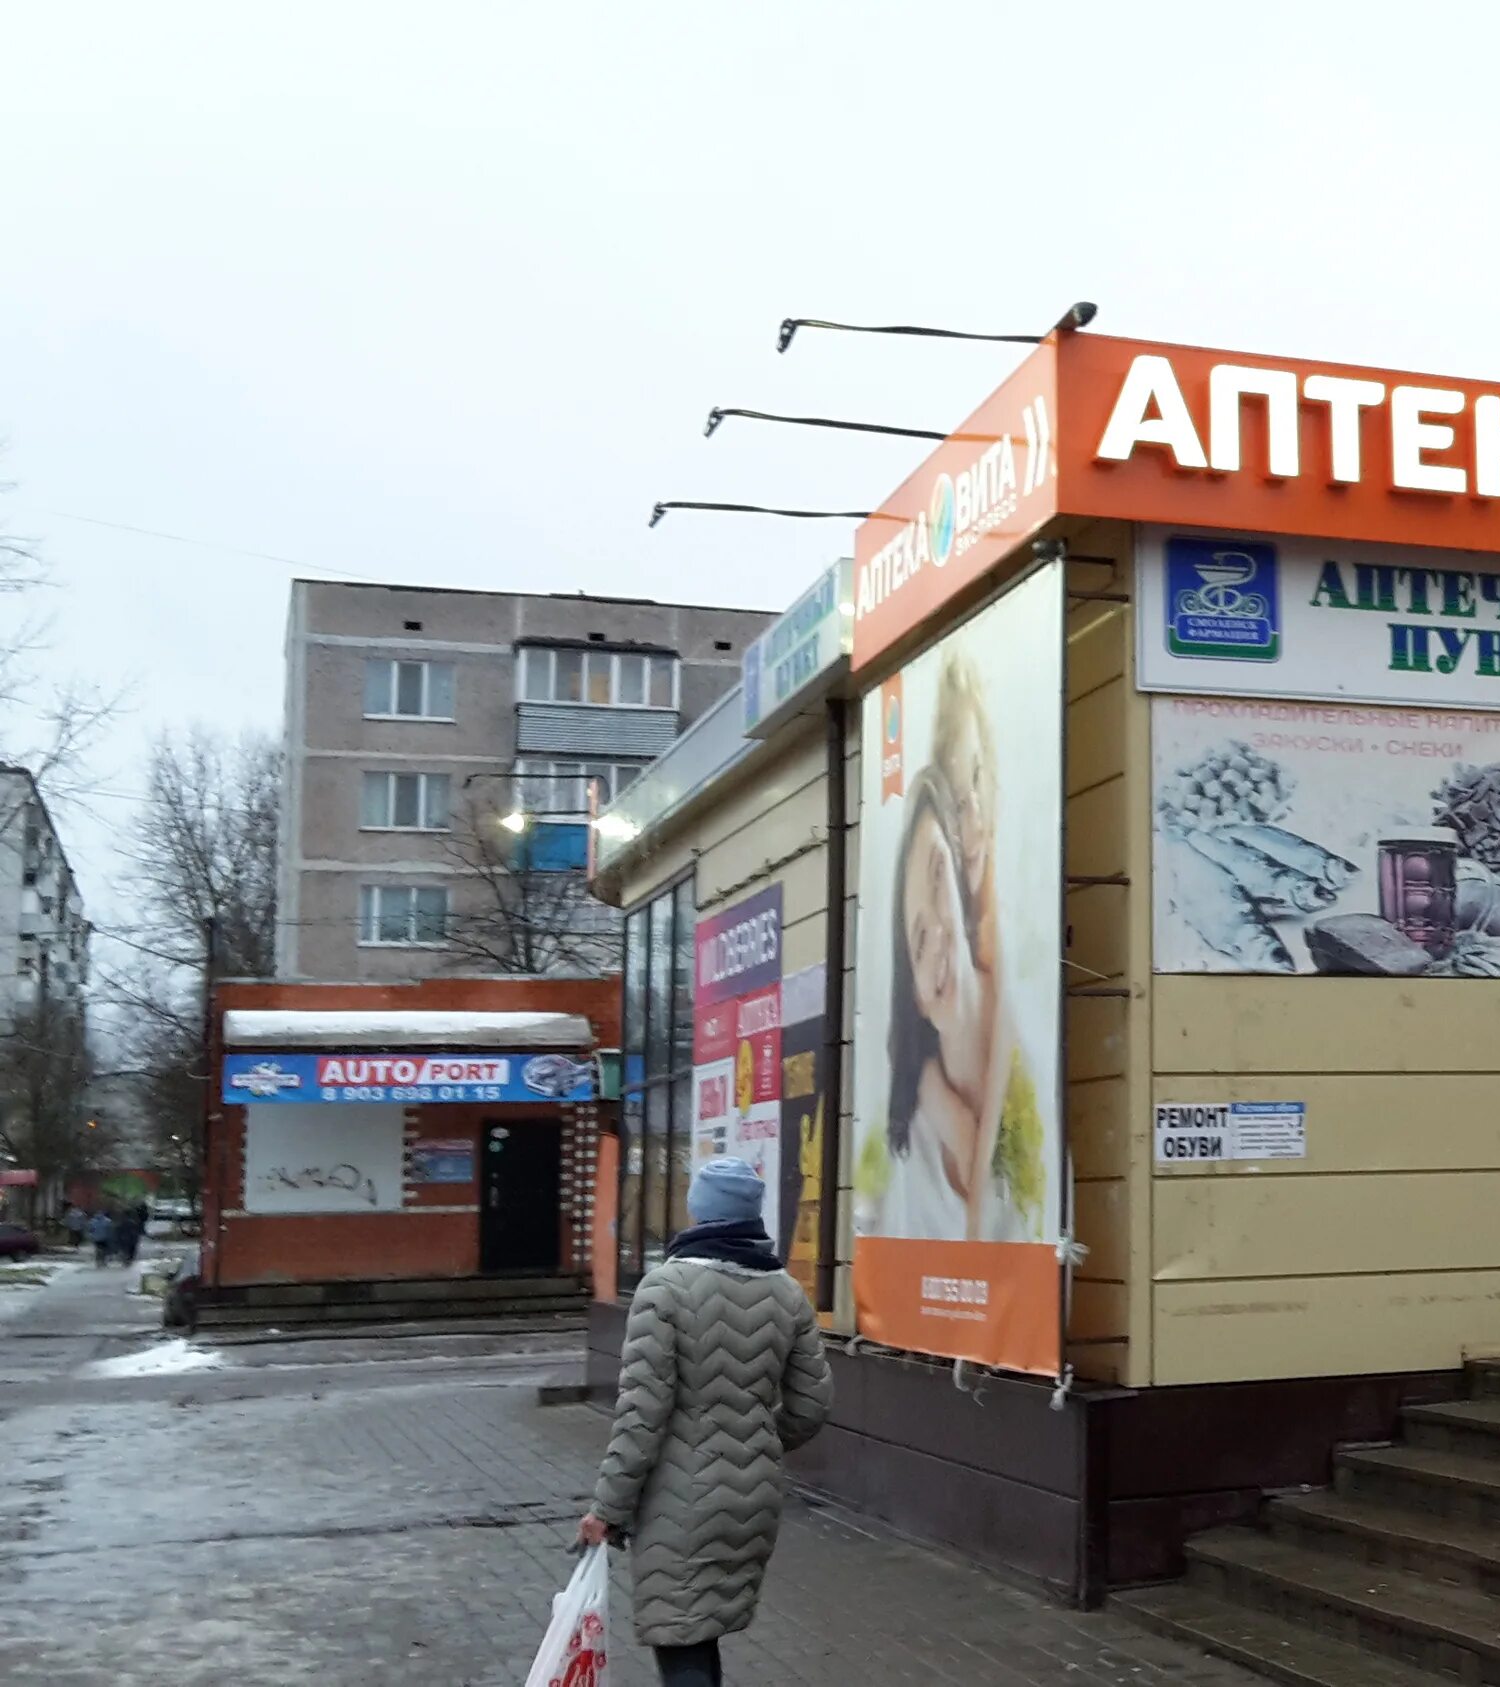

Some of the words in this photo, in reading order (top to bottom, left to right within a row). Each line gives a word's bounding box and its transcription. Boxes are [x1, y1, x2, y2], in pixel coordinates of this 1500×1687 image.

[855, 510, 930, 622] АПТЕКА
[955, 432, 1017, 535] ВИТА
[1252, 731, 1364, 753] ЗАКУСКИ
[1386, 740, 1463, 758] СНЕКИ
[320, 1059, 417, 1084] AUTO
[430, 1063, 499, 1081] PORT
[1156, 1107, 1229, 1128] РЕМОНТ
[1164, 1136, 1223, 1158] ОБУВИ
